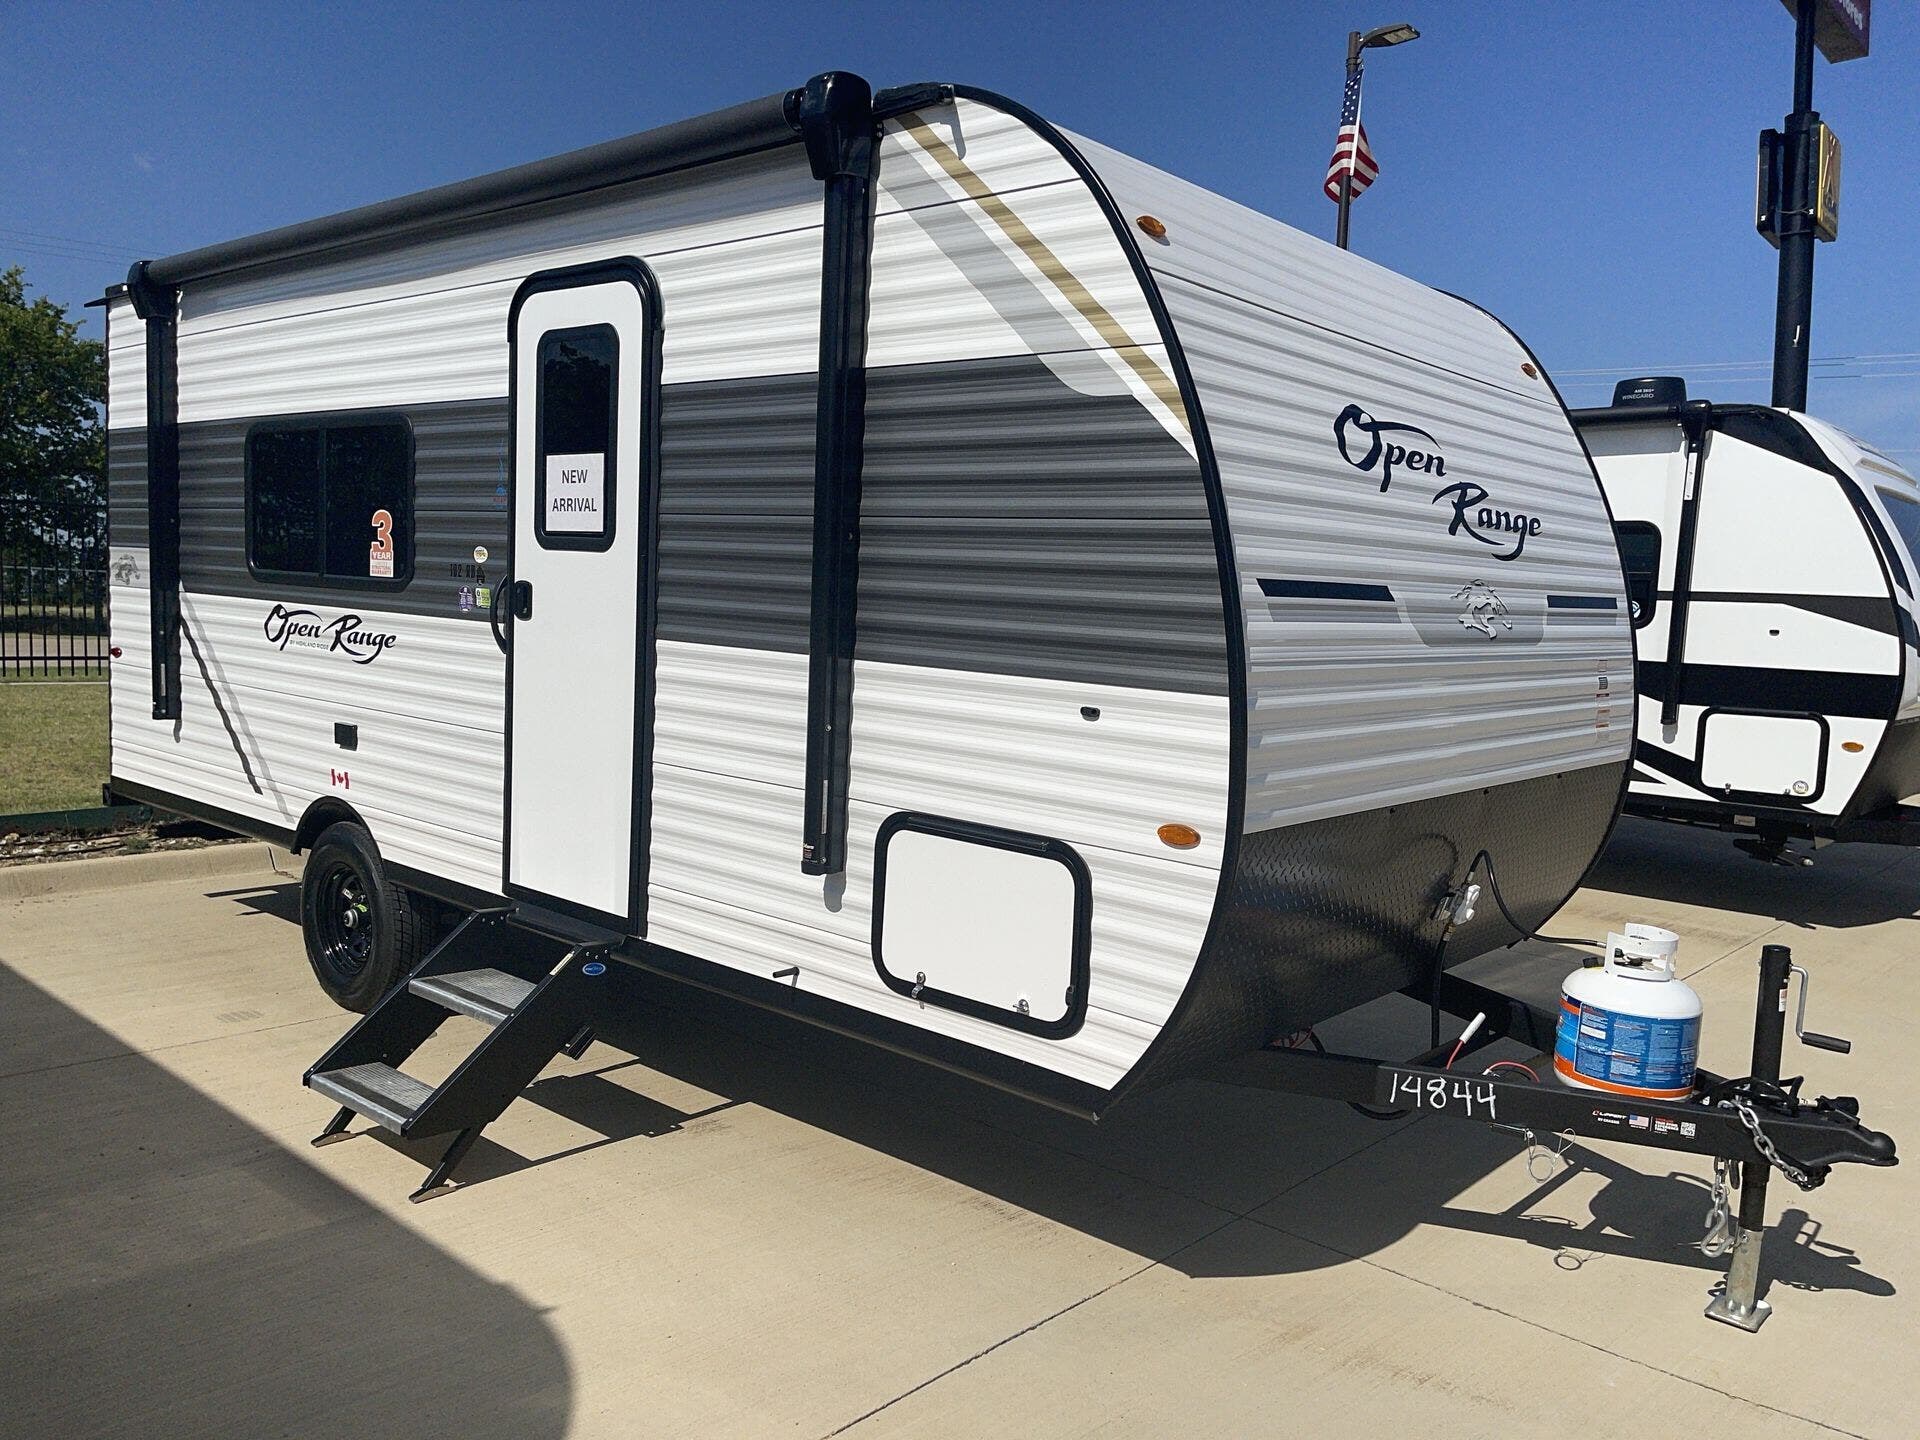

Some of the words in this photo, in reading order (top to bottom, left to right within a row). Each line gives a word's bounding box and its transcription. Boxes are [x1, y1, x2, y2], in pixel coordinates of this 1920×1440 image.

[1333, 403, 1446, 493] Open
[562, 469, 588, 484] NEW
[552, 497, 598, 512] ARRIVAL
[1432, 481, 1543, 562] Range
[371, 510, 393, 551] 3
[372, 551, 392, 560] YEAR
[264, 603, 324, 652] Open
[322, 614, 397, 665] Range
[1390, 1073, 1497, 1120] 14844
